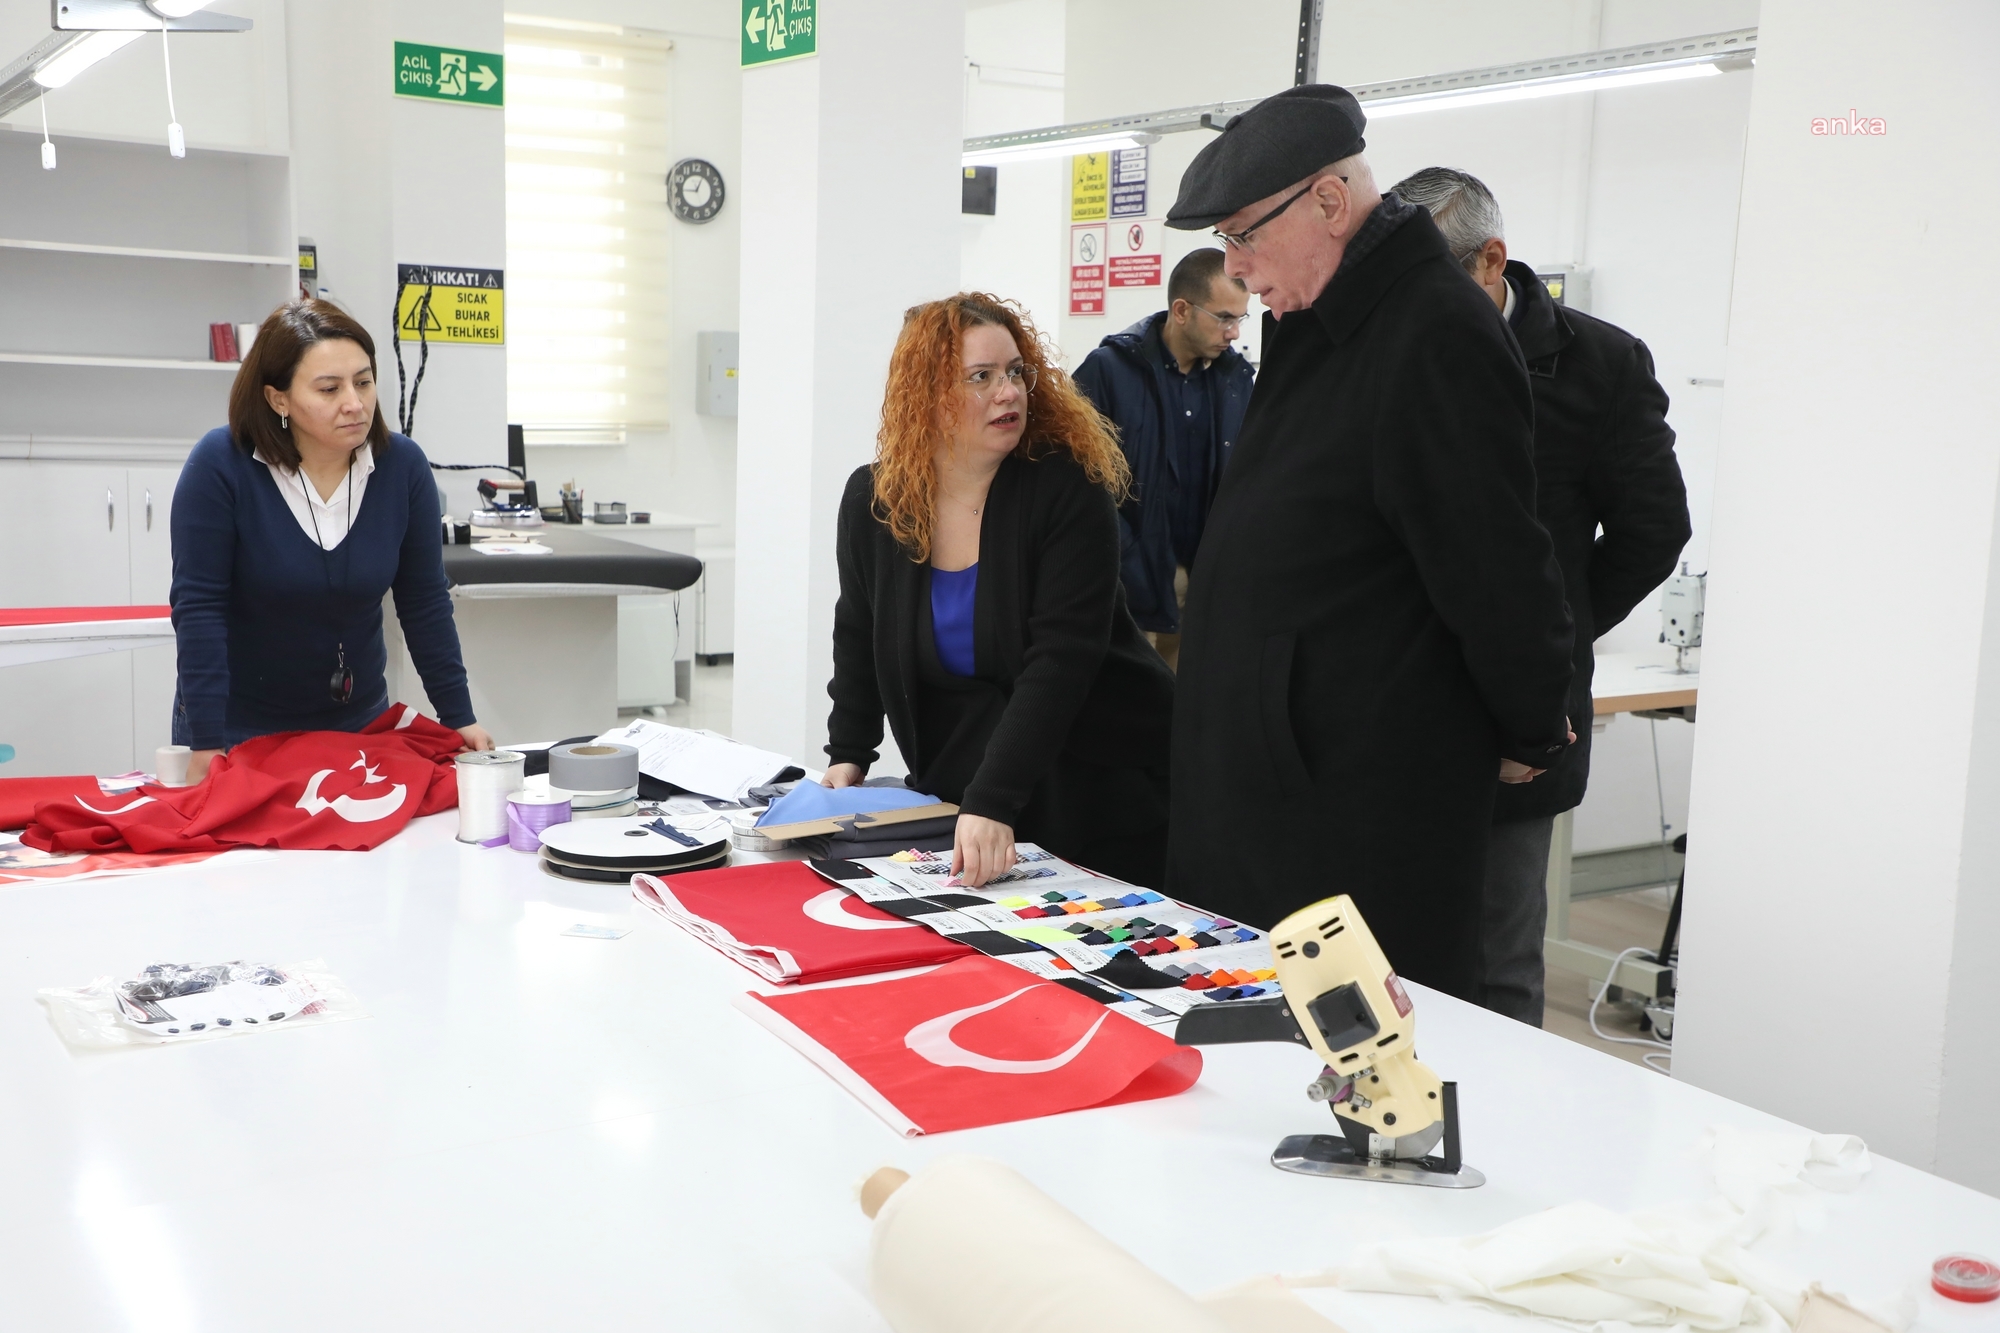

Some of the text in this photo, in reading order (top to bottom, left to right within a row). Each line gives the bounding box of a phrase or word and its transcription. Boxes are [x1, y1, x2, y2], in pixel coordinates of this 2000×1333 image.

[789, 16, 812, 40] ÇIKIŞ
[402, 54, 432, 70] ACİL
[400, 70, 433, 87] ÇIKIŞ
[457, 292, 488, 305] SICAK
[455, 309, 490, 322] BUHAR
[446, 324, 499, 339] TEHLİKESİ
